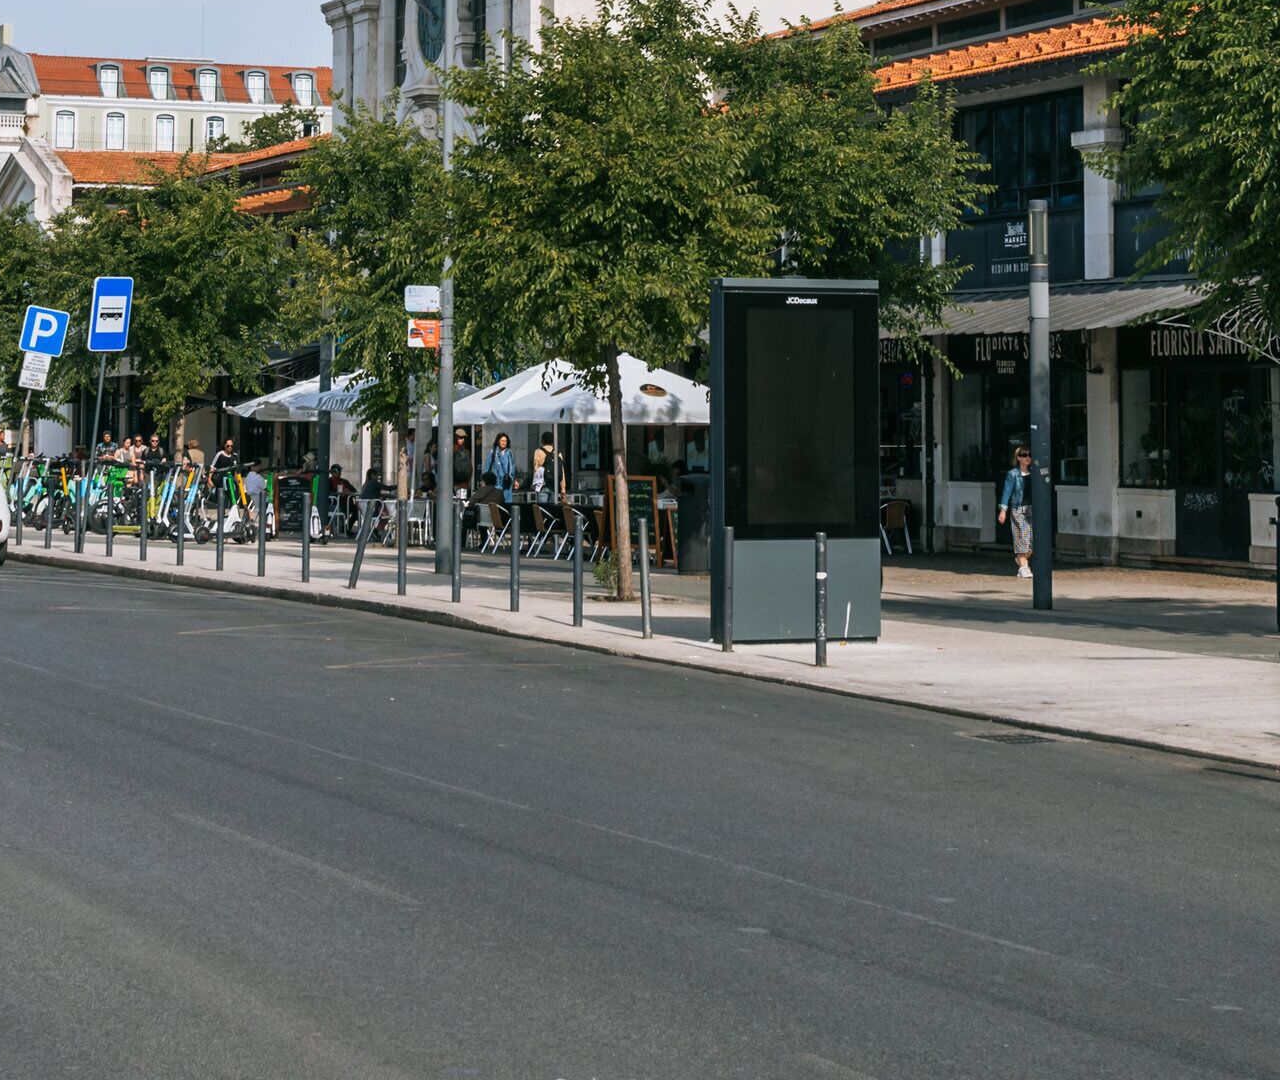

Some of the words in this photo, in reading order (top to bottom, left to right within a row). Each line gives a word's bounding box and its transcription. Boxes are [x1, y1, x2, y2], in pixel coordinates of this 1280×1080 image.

[1005, 236, 1026, 244] MARKET
[786, 296, 817, 304] JCDecaux
[29, 311, 58, 348] P
[1151, 328, 1204, 357] FLORISTA
